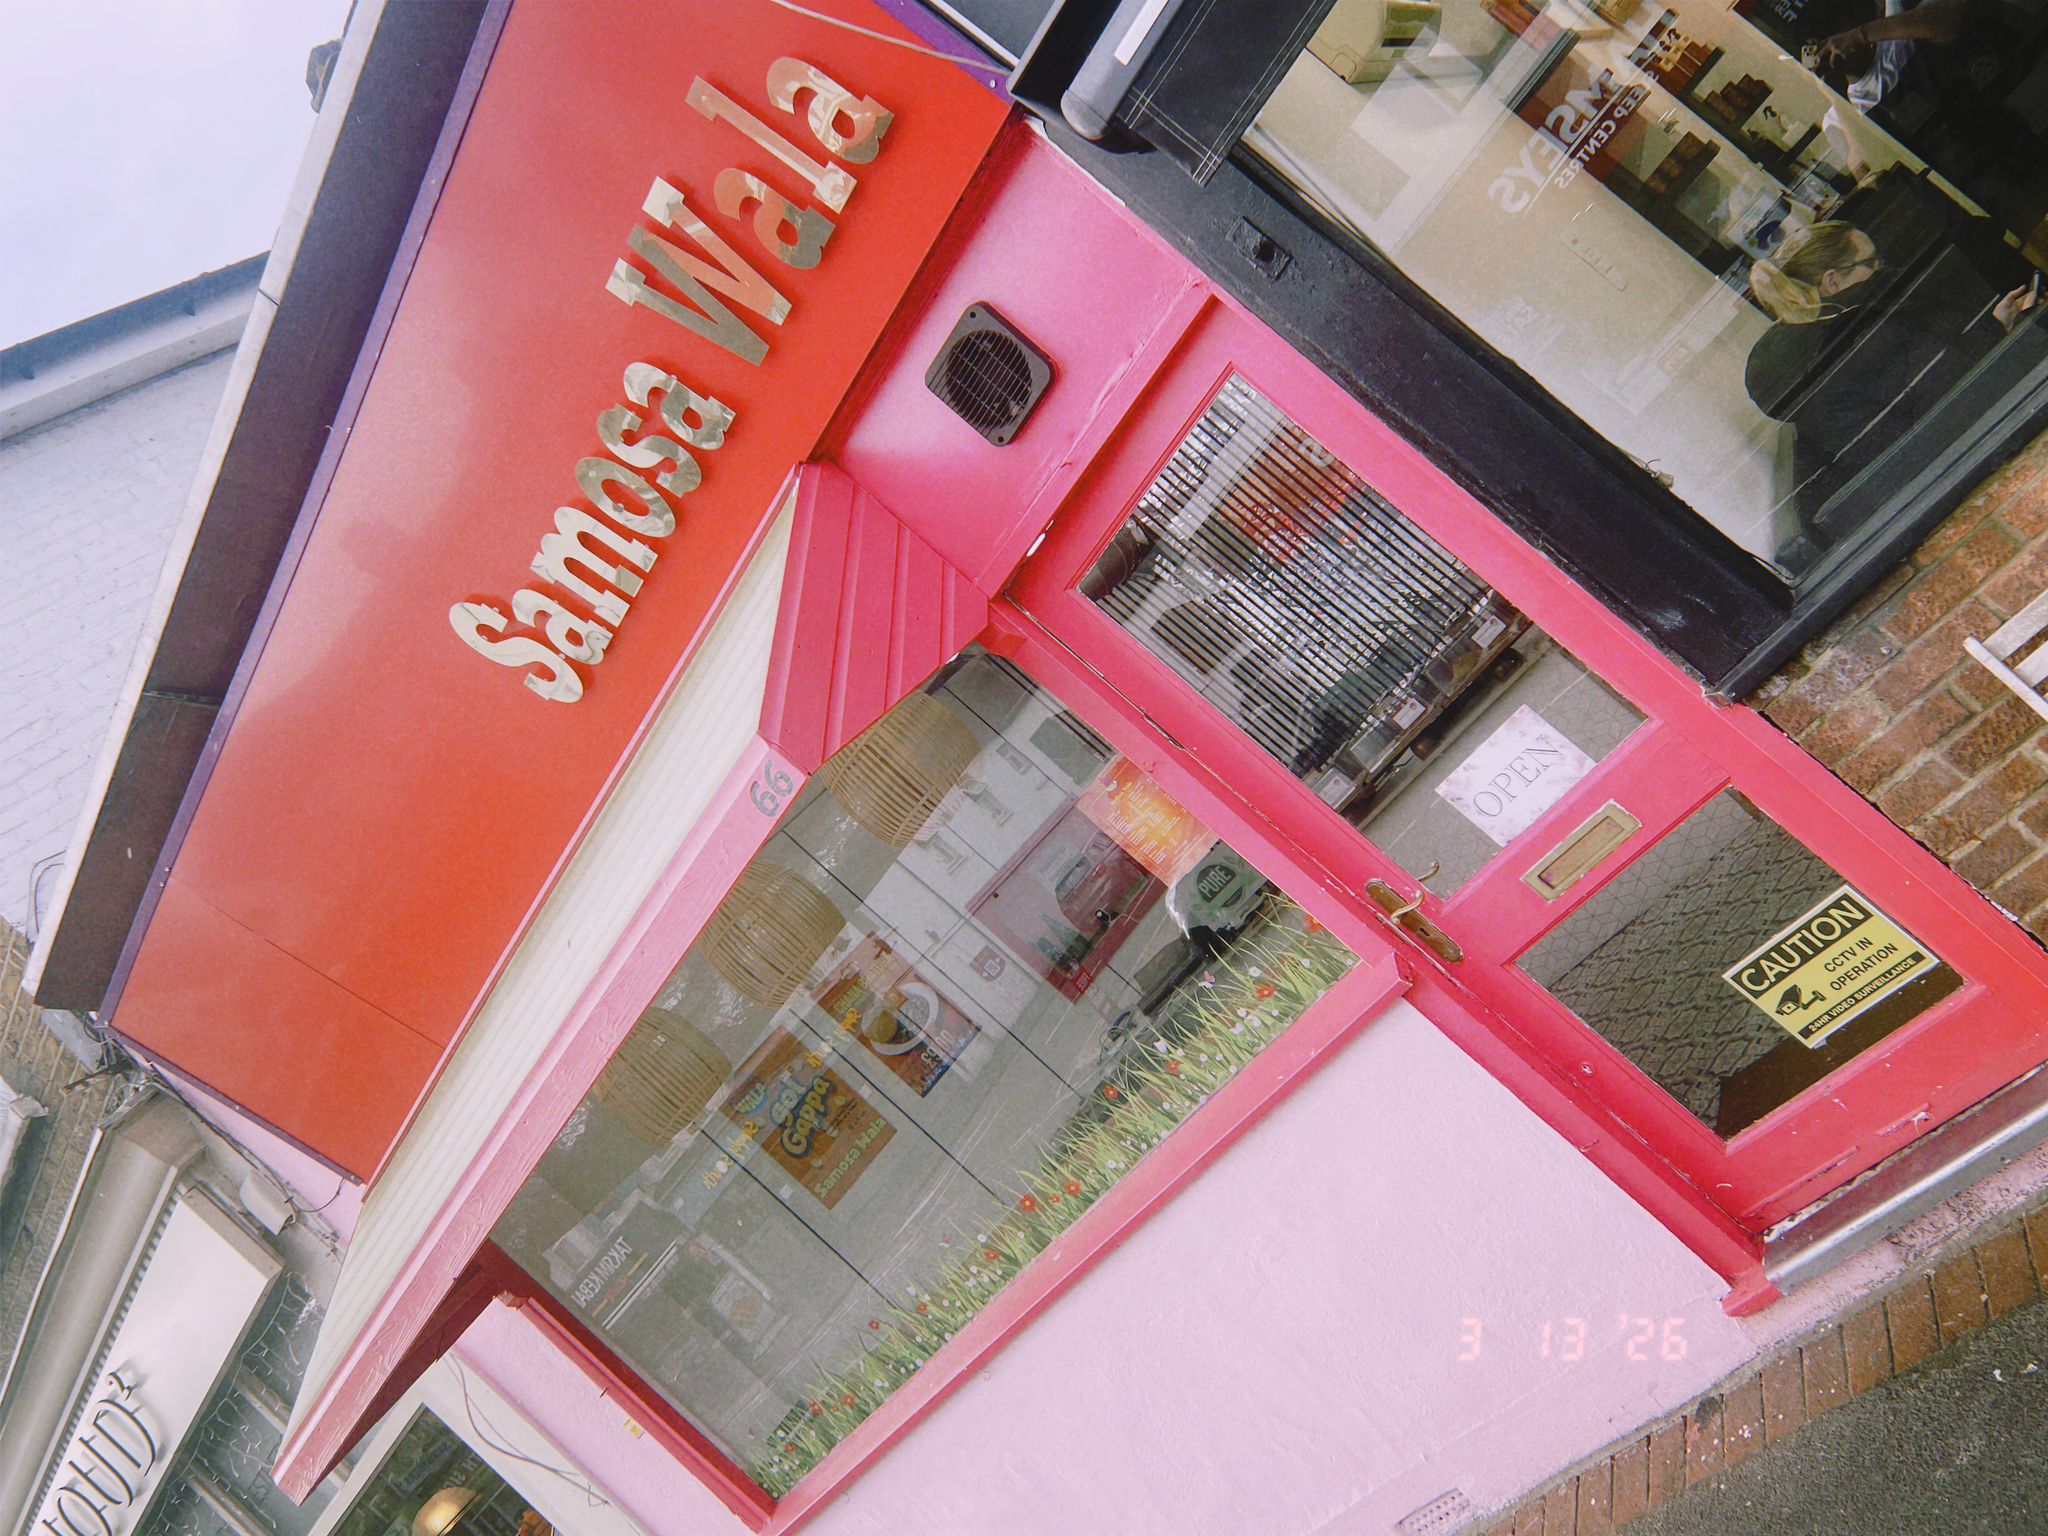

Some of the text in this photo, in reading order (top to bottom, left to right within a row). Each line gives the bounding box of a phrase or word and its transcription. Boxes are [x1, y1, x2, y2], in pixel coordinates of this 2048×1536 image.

[448, 56, 895, 703] Samosa Wala
[750, 760, 793, 817] 66
[1473, 734, 1562, 817] OPEN
[1198, 866, 1232, 898] PURE
[1740, 899, 1866, 992] CAUTION
[1824, 937, 1874, 973] CCTV IN
[1830, 942, 1899, 991] OPERATION
[1808, 957, 1916, 1032] 24HR VIDEO SURVEILLANCE
[782, 1076, 832, 1155] Gappa
[815, 1149, 860, 1198] Samosa
